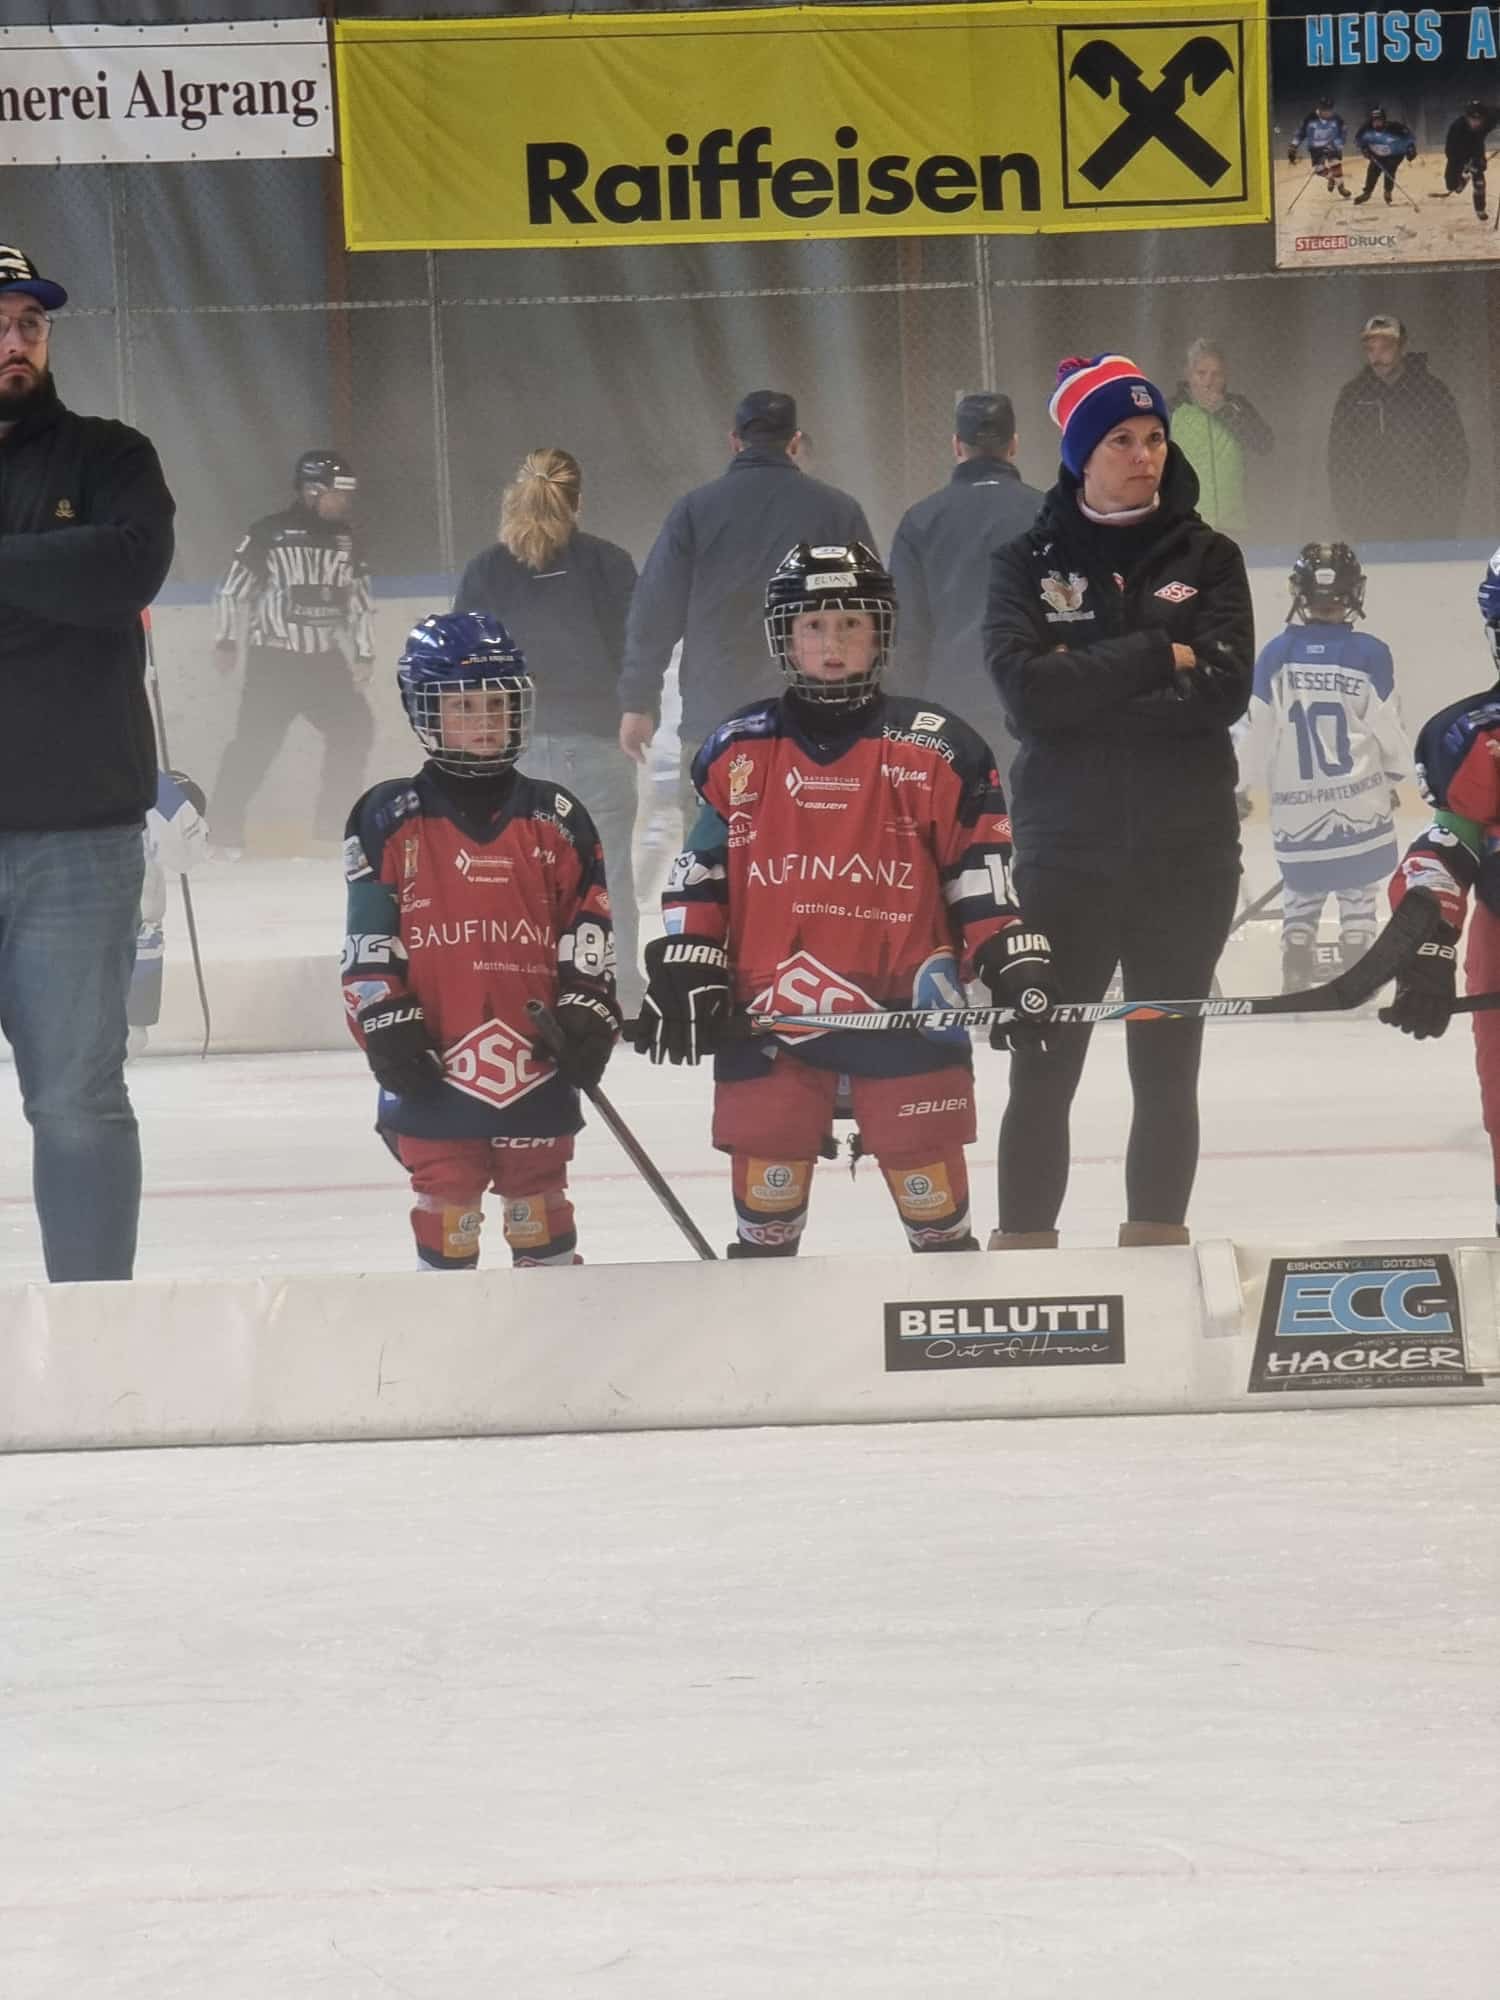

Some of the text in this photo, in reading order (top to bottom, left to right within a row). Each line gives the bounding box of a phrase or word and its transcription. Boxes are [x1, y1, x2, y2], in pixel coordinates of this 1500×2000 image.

[1306, 7, 1497, 66] HEISS A
[124, 69, 318, 130] Algrang
[526, 126, 1042, 225] Raiffeisen
[1288, 700, 1354, 780] 10
[748, 852, 914, 889] AUFINANZ
[410, 918, 556, 950] BAUFINAN
[1199, 1000, 1254, 1016] NOVA
[491, 1136, 556, 1149] CCM
[900, 1303, 1109, 1337] BELLUTTI
[925, 1339, 1003, 1360] Out
[1025, 1332, 1109, 1359] Home
[1267, 1346, 1464, 1374] HACKER
